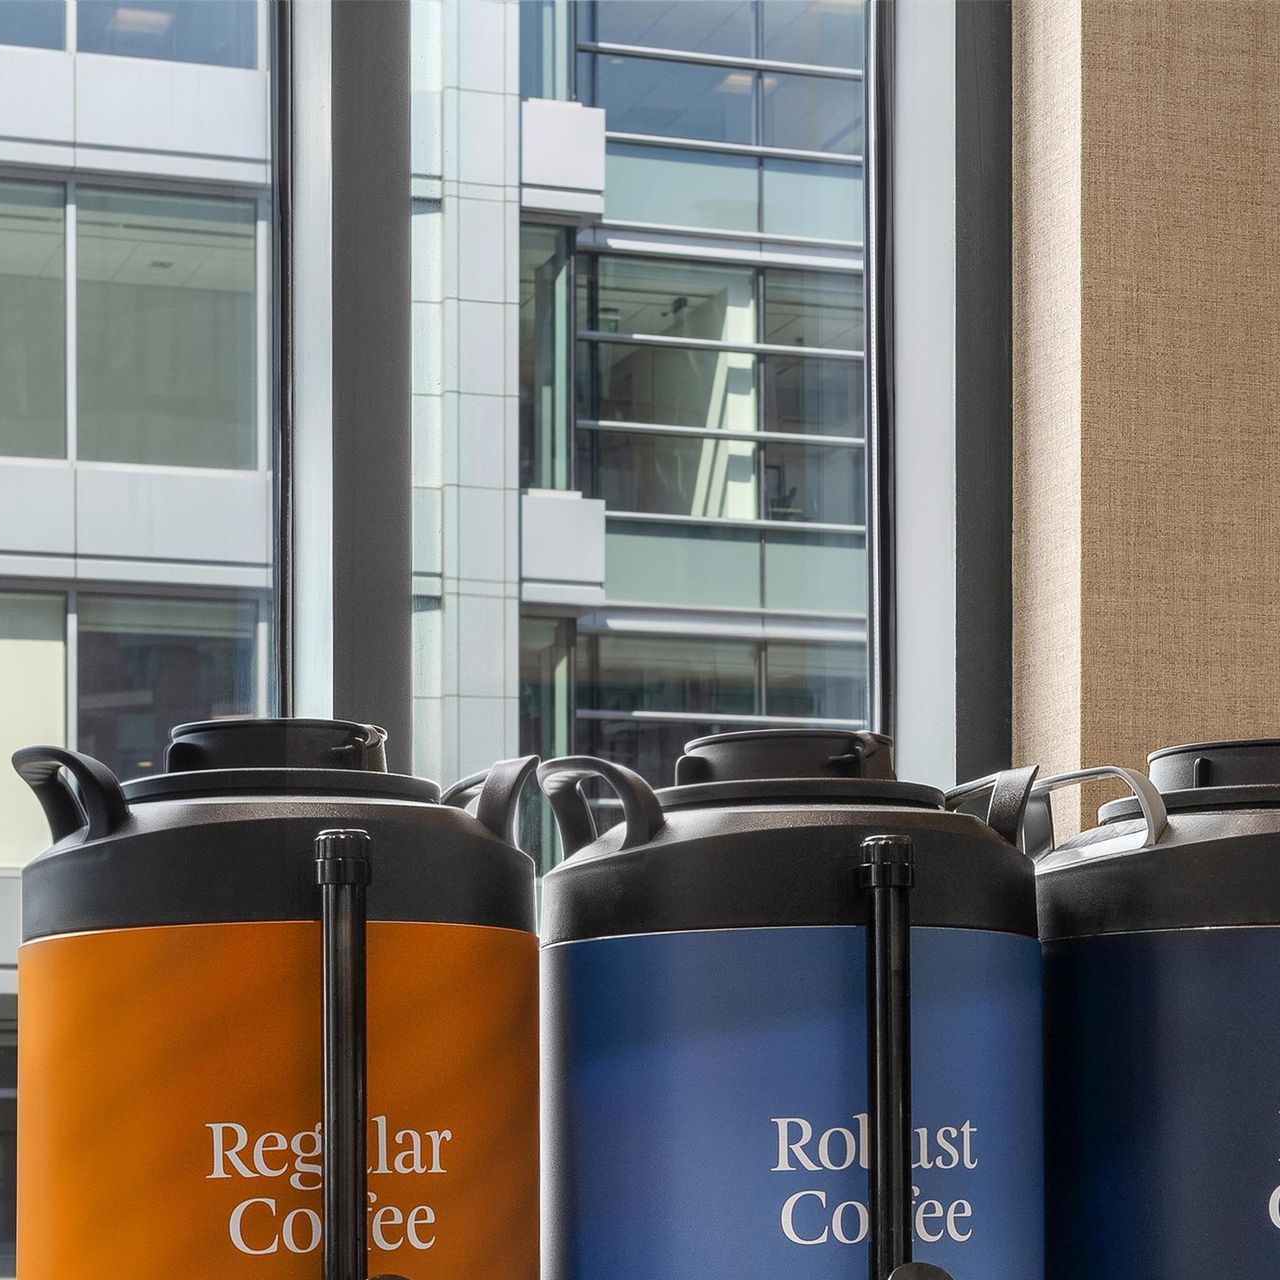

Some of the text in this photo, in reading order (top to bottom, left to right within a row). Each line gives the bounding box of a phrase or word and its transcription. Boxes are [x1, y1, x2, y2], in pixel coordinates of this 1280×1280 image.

[205, 1115, 452, 1191] Reglar
[229, 1191, 436, 1256] Coee
[780, 1185, 973, 1245] Coee
